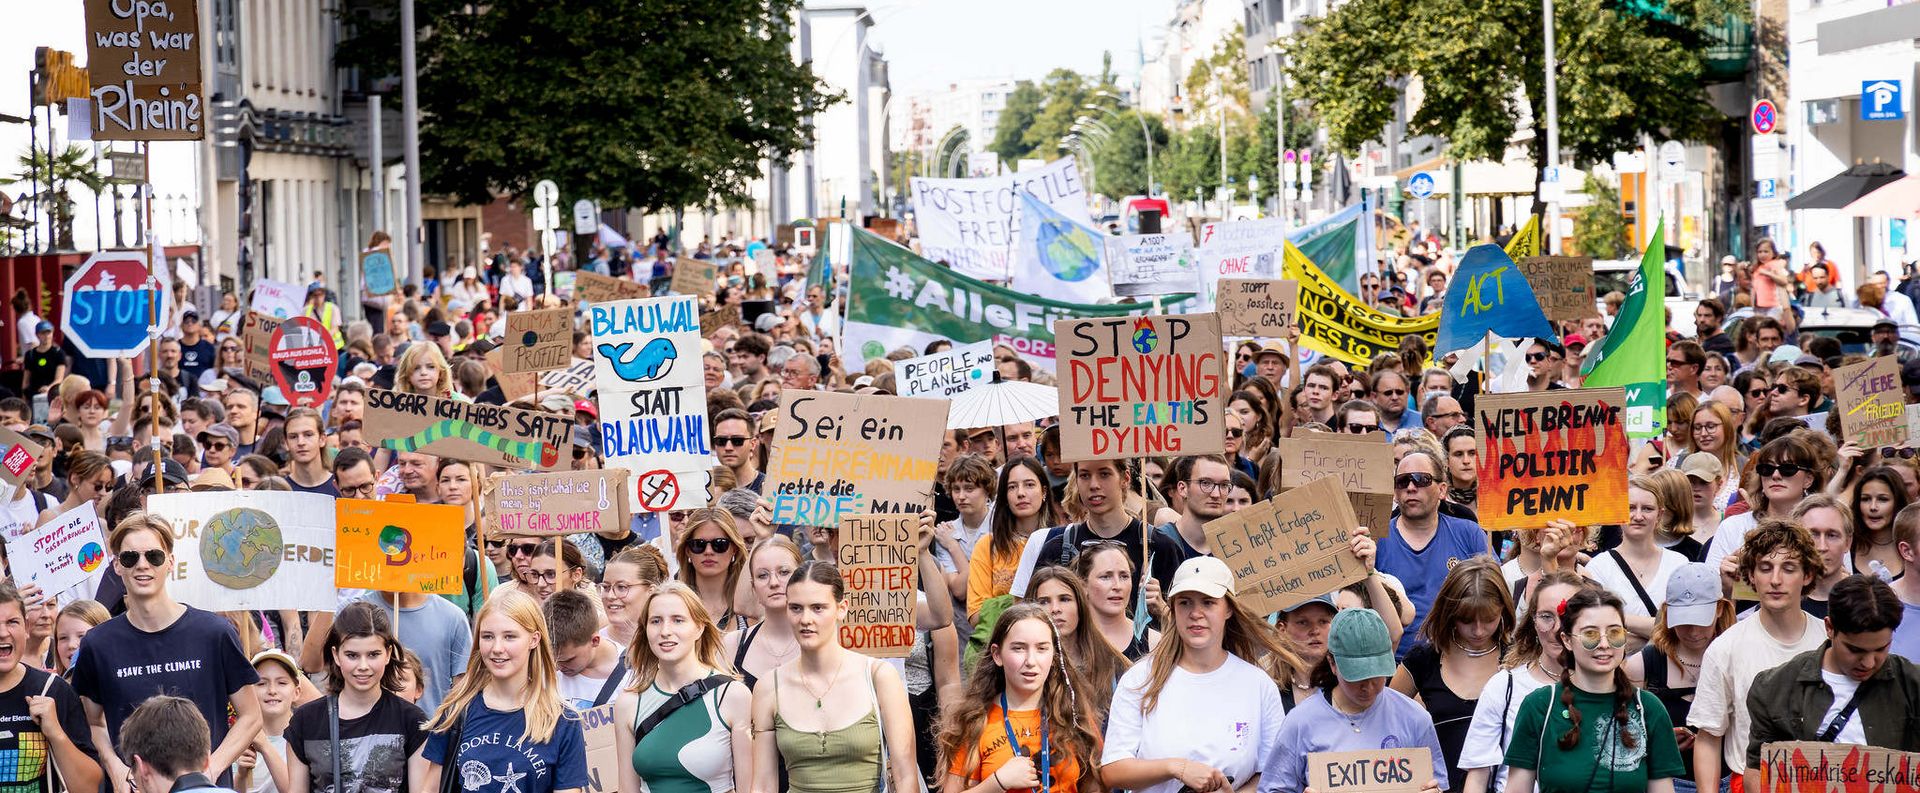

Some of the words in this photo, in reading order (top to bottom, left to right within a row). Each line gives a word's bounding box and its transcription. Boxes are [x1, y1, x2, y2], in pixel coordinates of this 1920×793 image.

[111, 0, 174, 33] Opa,
[95, 31, 141, 48] was
[148, 31, 194, 50] war
[122, 51, 167, 76] der
[1204, 224, 1214, 244] 7
[1220, 256, 1250, 275] OHNE
[1241, 282, 1270, 293] STOPPT
[1460, 266, 1508, 318] ACT
[1247, 297, 1285, 311] fossiles
[1301, 287, 1338, 319] NO
[509, 314, 553, 332] KLIMA
[592, 300, 699, 337] BLAUWAL
[1261, 312, 1292, 328] GAS!
[539, 329, 561, 343] vor
[1301, 313, 1342, 349] YES
[1347, 335, 1372, 358] to
[905, 352, 974, 379] PEOPLE
[977, 354, 993, 365] AND
[910, 369, 971, 396] PLANET
[944, 383, 971, 396] OVER
[1069, 353, 1219, 404] DENYING
[1862, 373, 1897, 395] LIEBE
[368, 389, 427, 416] SOGAR
[434, 399, 461, 420] ICH
[630, 387, 684, 418] STATT
[1071, 405, 1120, 427] THE
[1133, 398, 1208, 425] EARTH'S
[1866, 401, 1905, 421] FRIEDEN
[788, 397, 844, 441] Sei
[861, 417, 904, 441] ein
[1481, 406, 1538, 440] WELT
[1541, 404, 1621, 432] BRENNT
[602, 415, 710, 458] BLAUWAHL
[1092, 425, 1181, 455] DYING
[1303, 450, 1331, 468] Für
[1336, 454, 1366, 470] eine
[1500, 449, 1597, 479] POLITIK
[501, 480, 524, 496] this
[550, 478, 574, 495] what
[576, 480, 589, 493] we
[778, 478, 825, 495] rette
[830, 478, 855, 496] die
[1506, 483, 1589, 516] PENNT
[500, 499, 523, 509] mean
[528, 496, 542, 512] by
[173, 519, 199, 540] ÜR
[342, 526, 371, 536] aus
[500, 511, 523, 530] HOT
[527, 511, 555, 531] GIRL
[556, 509, 603, 531] SUMMER
[845, 519, 887, 541] THIS
[895, 519, 910, 541] IS
[33, 525, 65, 554] STOPPT
[69, 517, 82, 529] DIE
[1216, 531, 1243, 559] Es
[1243, 522, 1277, 551] heißt
[1275, 508, 1326, 535] Erdgas,
[168, 561, 188, 581] IE
[284, 543, 334, 567] ERDE
[840, 544, 917, 565] GETTING
[1235, 561, 1258, 580] weil
[1263, 557, 1277, 570] es
[1280, 549, 1292, 562] in
[1294, 540, 1310, 556] der
[1314, 528, 1349, 551] Erde
[841, 566, 913, 590] HOTTER
[1260, 574, 1305, 599] bleiben
[1308, 554, 1346, 582] muss!
[843, 592, 880, 606] THAN
[888, 591, 910, 607] MY
[842, 608, 913, 624] MAGINARY
[839, 625, 916, 650] BOYFRIEND
[116, 666, 143, 678] #SAVE
[145, 664, 162, 675] THE
[164, 659, 201, 672] CLIMATE
[505, 735, 524, 752] LA
[524, 748, 547, 780] MER
[1767, 748, 1858, 785] Klimakrise
[1326, 760, 1370, 787] EXIT
[1373, 757, 1412, 783] GAS
